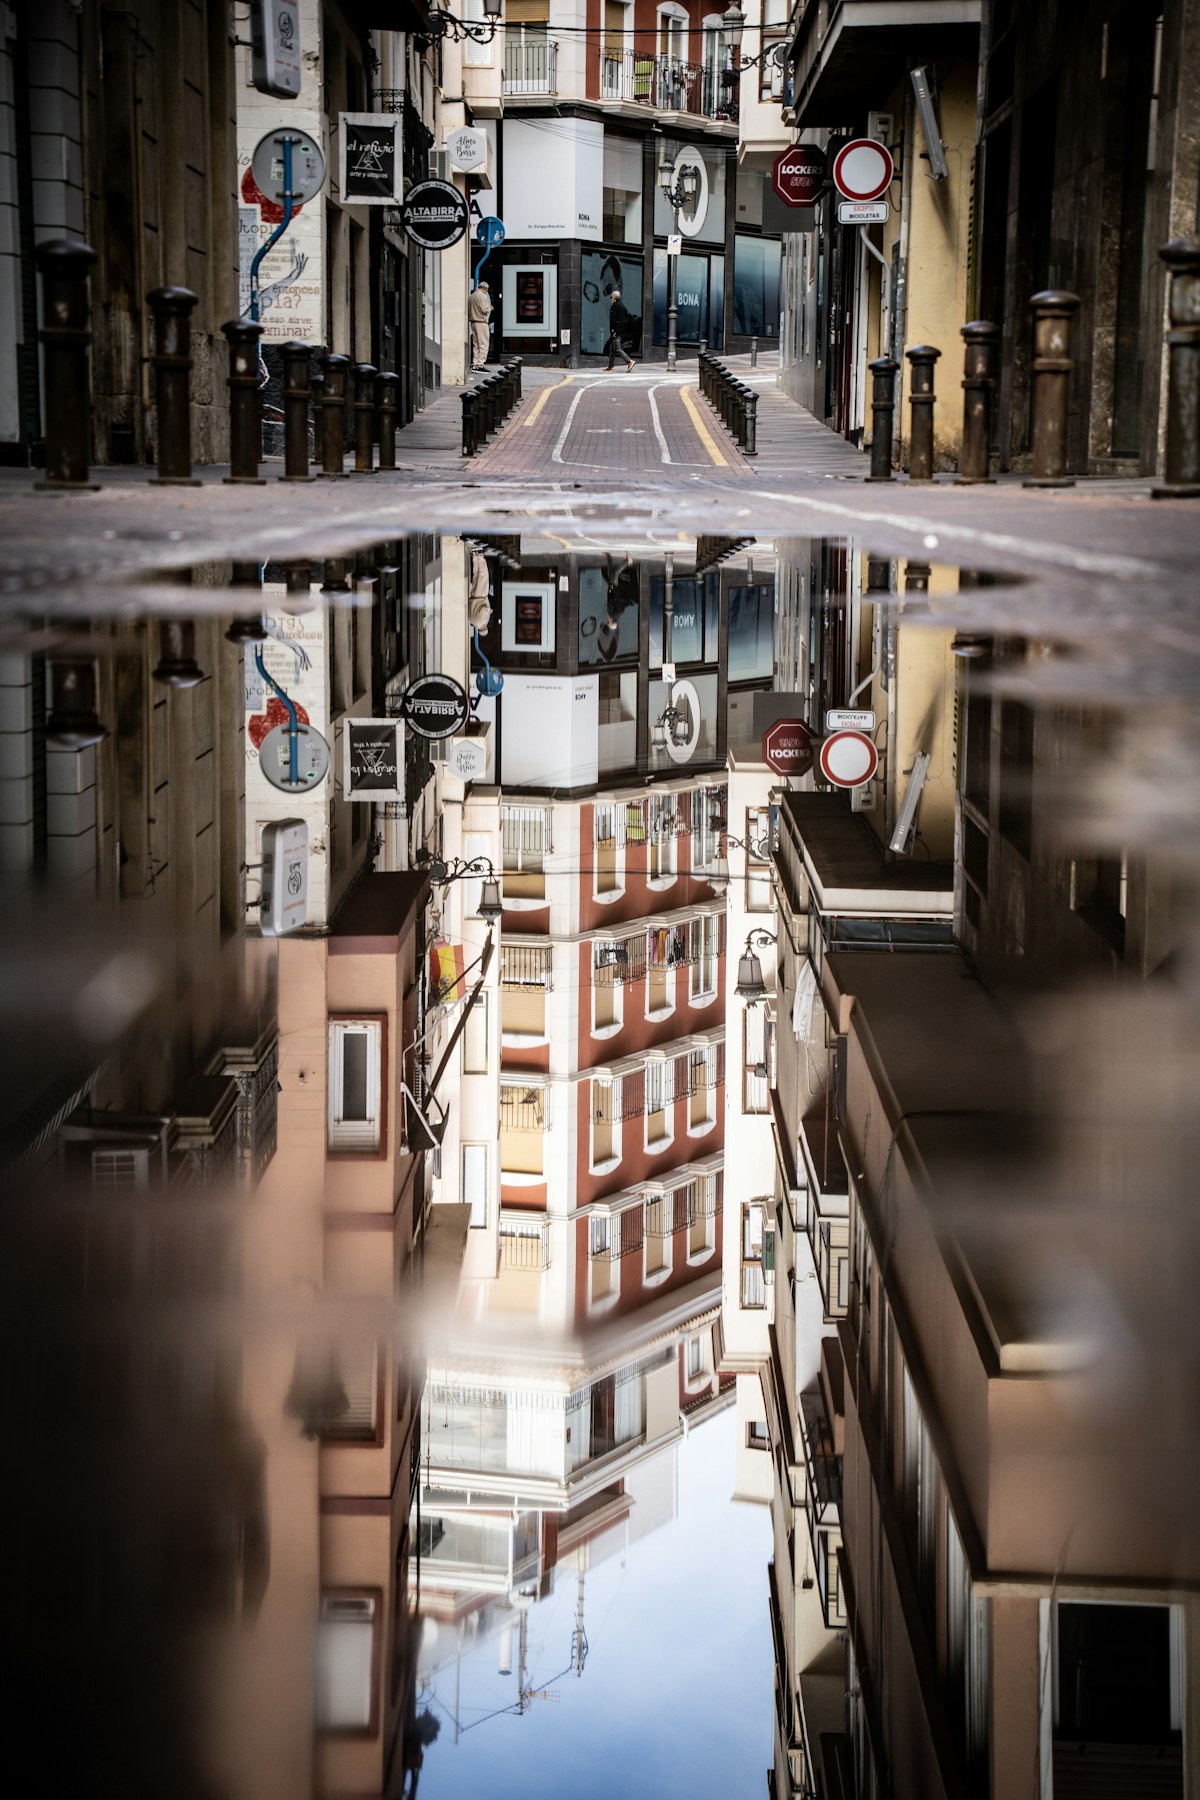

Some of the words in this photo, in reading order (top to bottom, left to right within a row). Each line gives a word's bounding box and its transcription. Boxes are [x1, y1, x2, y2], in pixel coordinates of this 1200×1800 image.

[347, 140, 357, 151] el
[359, 140, 394, 158] refugio
[781, 165, 824, 175] LOCKERS
[790, 176, 814, 187] STOP
[404, 206, 465, 218] ALTABIRRA
[578, 213, 590, 221] BONA
[272, 284, 320, 295] entonces
[678, 293, 700, 307] BONA
[288, 316, 312, 324] sirve
